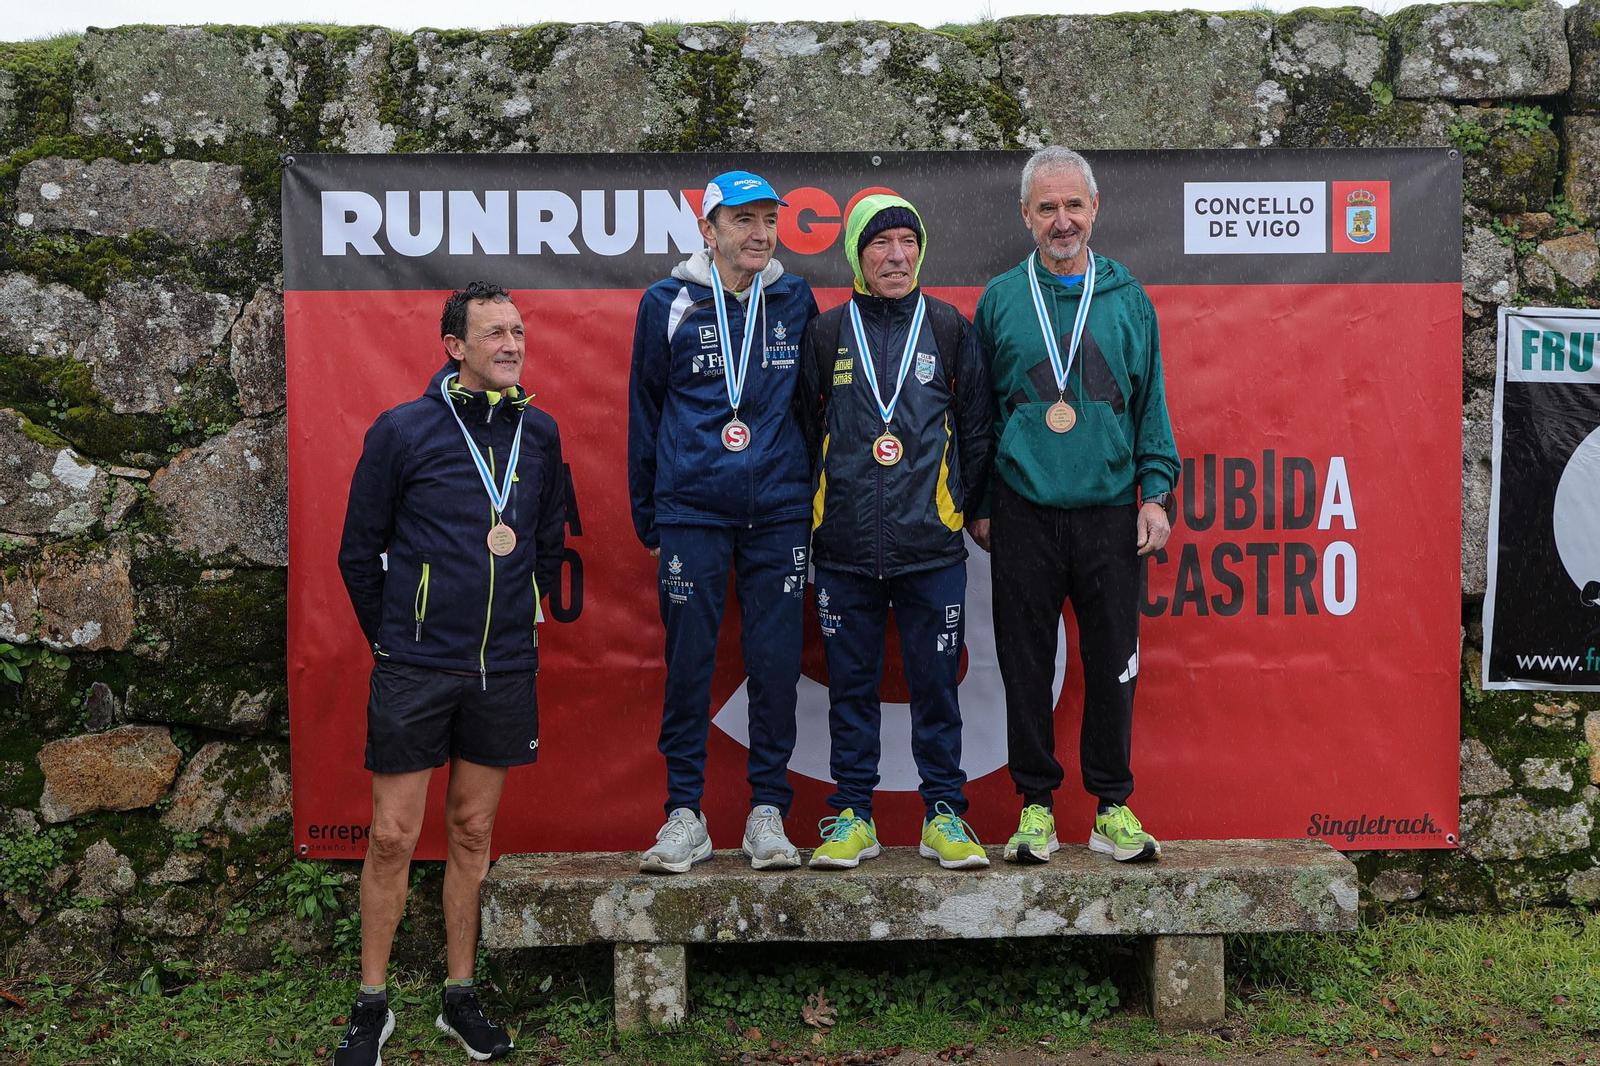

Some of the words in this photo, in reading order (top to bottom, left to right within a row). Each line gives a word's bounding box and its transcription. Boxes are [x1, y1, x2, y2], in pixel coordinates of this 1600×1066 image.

[1194, 197, 1314, 215] CONCELLO
[1209, 221, 1238, 237] DE
[1246, 220, 1300, 237] VIGO
[766, 350, 799, 359] SAMIL
[1522, 330, 1600, 372] FRU
[1140, 541, 1357, 617] CASTRO
